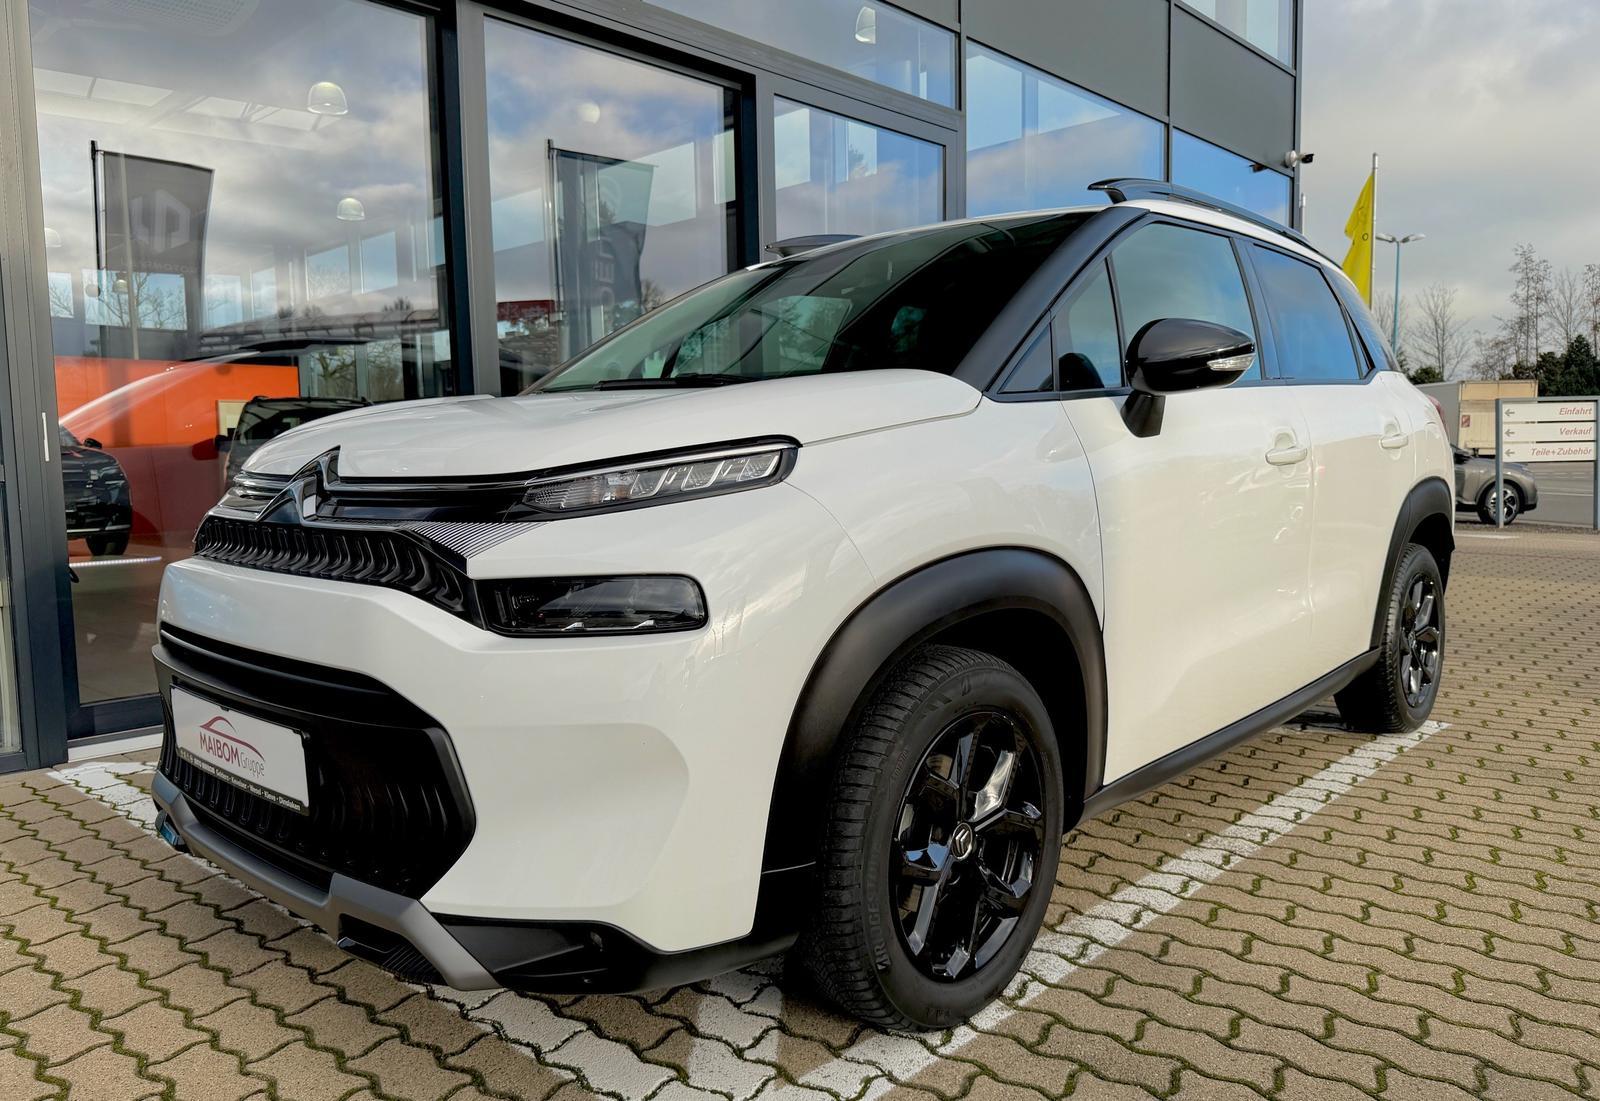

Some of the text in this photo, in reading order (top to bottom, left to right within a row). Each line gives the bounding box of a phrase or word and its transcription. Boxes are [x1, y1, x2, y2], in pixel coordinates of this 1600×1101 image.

[1559, 407, 1593, 416] Einfahrt
[1559, 427, 1593, 436] Verkauf
[199, 731, 241, 768] MAIBOM
[240, 752, 265, 779] Gruppe
